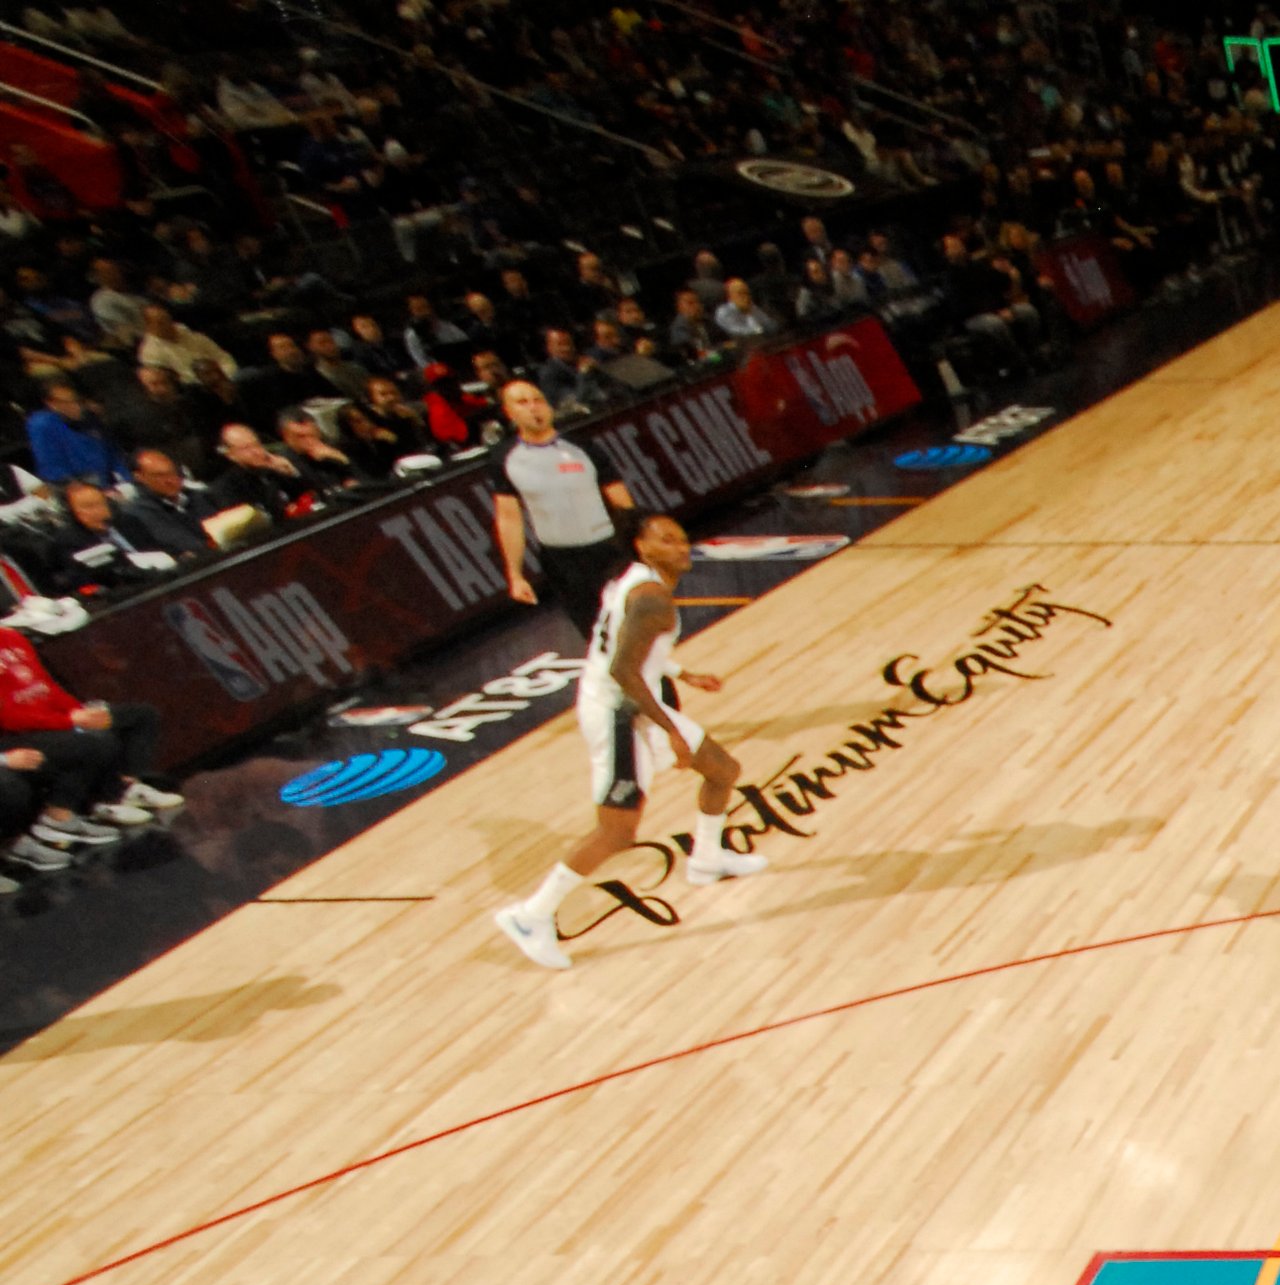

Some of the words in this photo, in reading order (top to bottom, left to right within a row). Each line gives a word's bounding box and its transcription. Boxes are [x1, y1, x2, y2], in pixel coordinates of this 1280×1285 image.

[379, 495, 508, 612] TAP
[592, 423, 685, 512] HE
[646, 385, 773, 496] GAME
[211, 580, 355, 690] App
[882, 583, 1114, 717] Equity
[407, 651, 588, 742] AT&T
